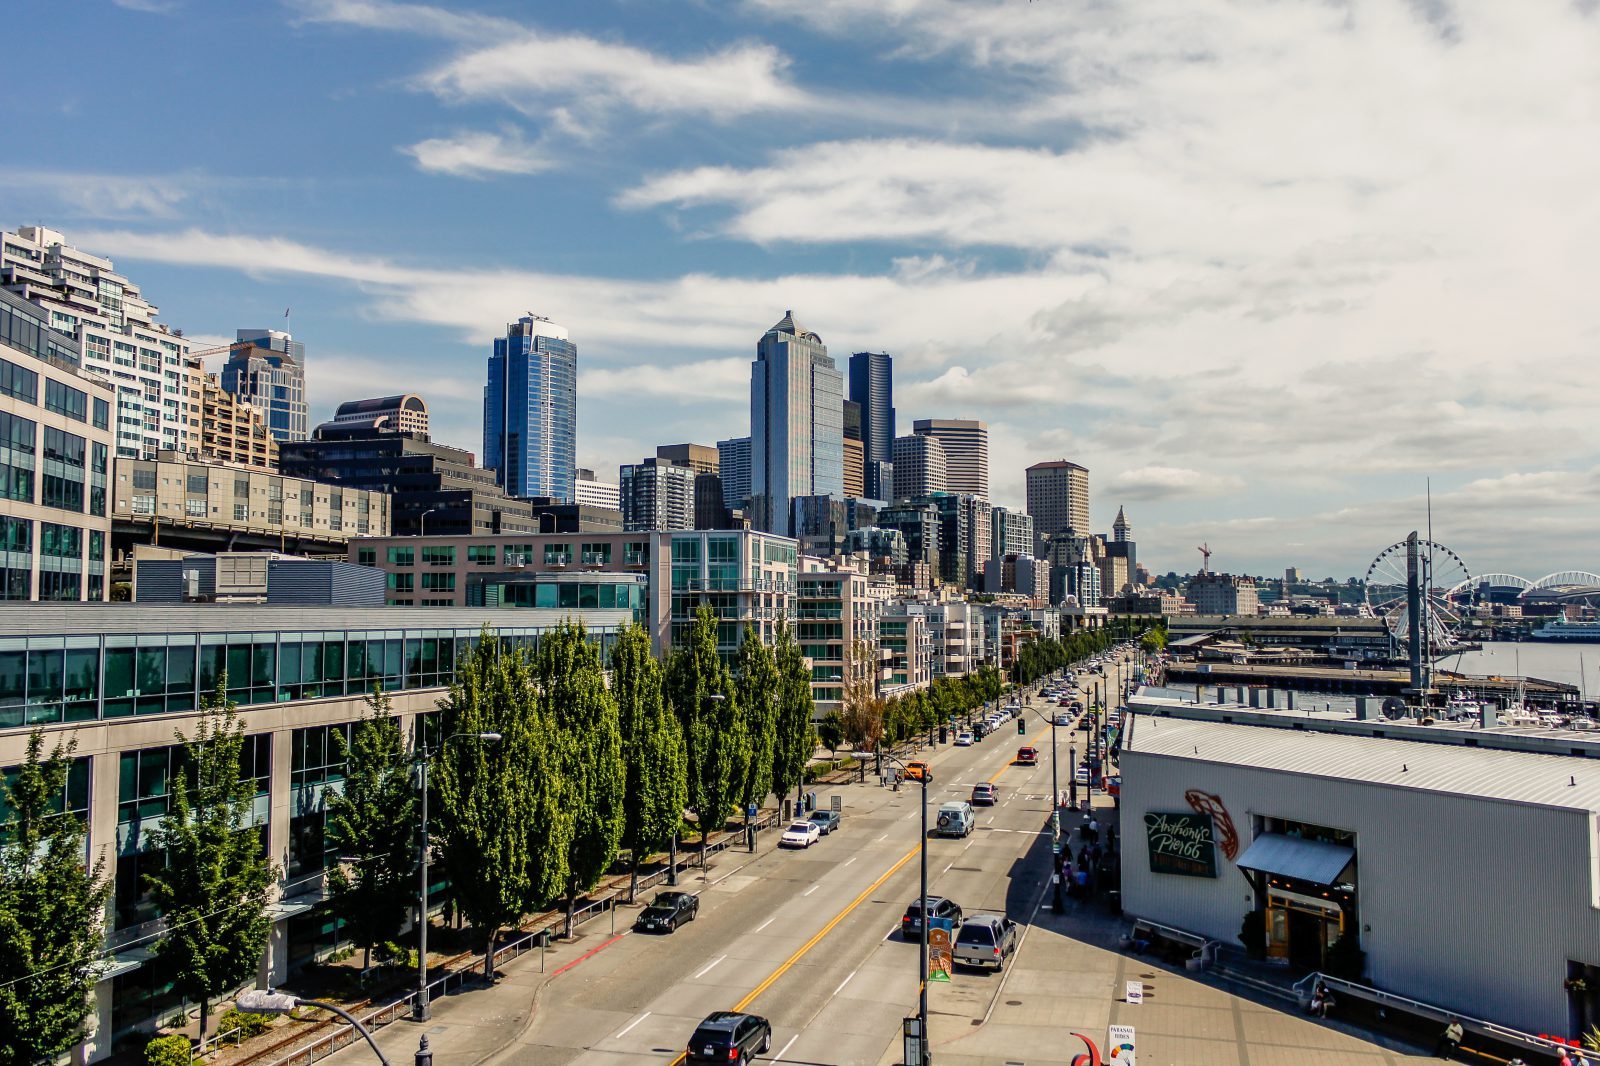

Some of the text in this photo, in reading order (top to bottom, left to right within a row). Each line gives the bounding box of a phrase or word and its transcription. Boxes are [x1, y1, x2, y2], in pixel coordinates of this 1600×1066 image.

[1144, 814, 1214, 844] Anthony's
[1150, 833, 1203, 859] Pier 66
